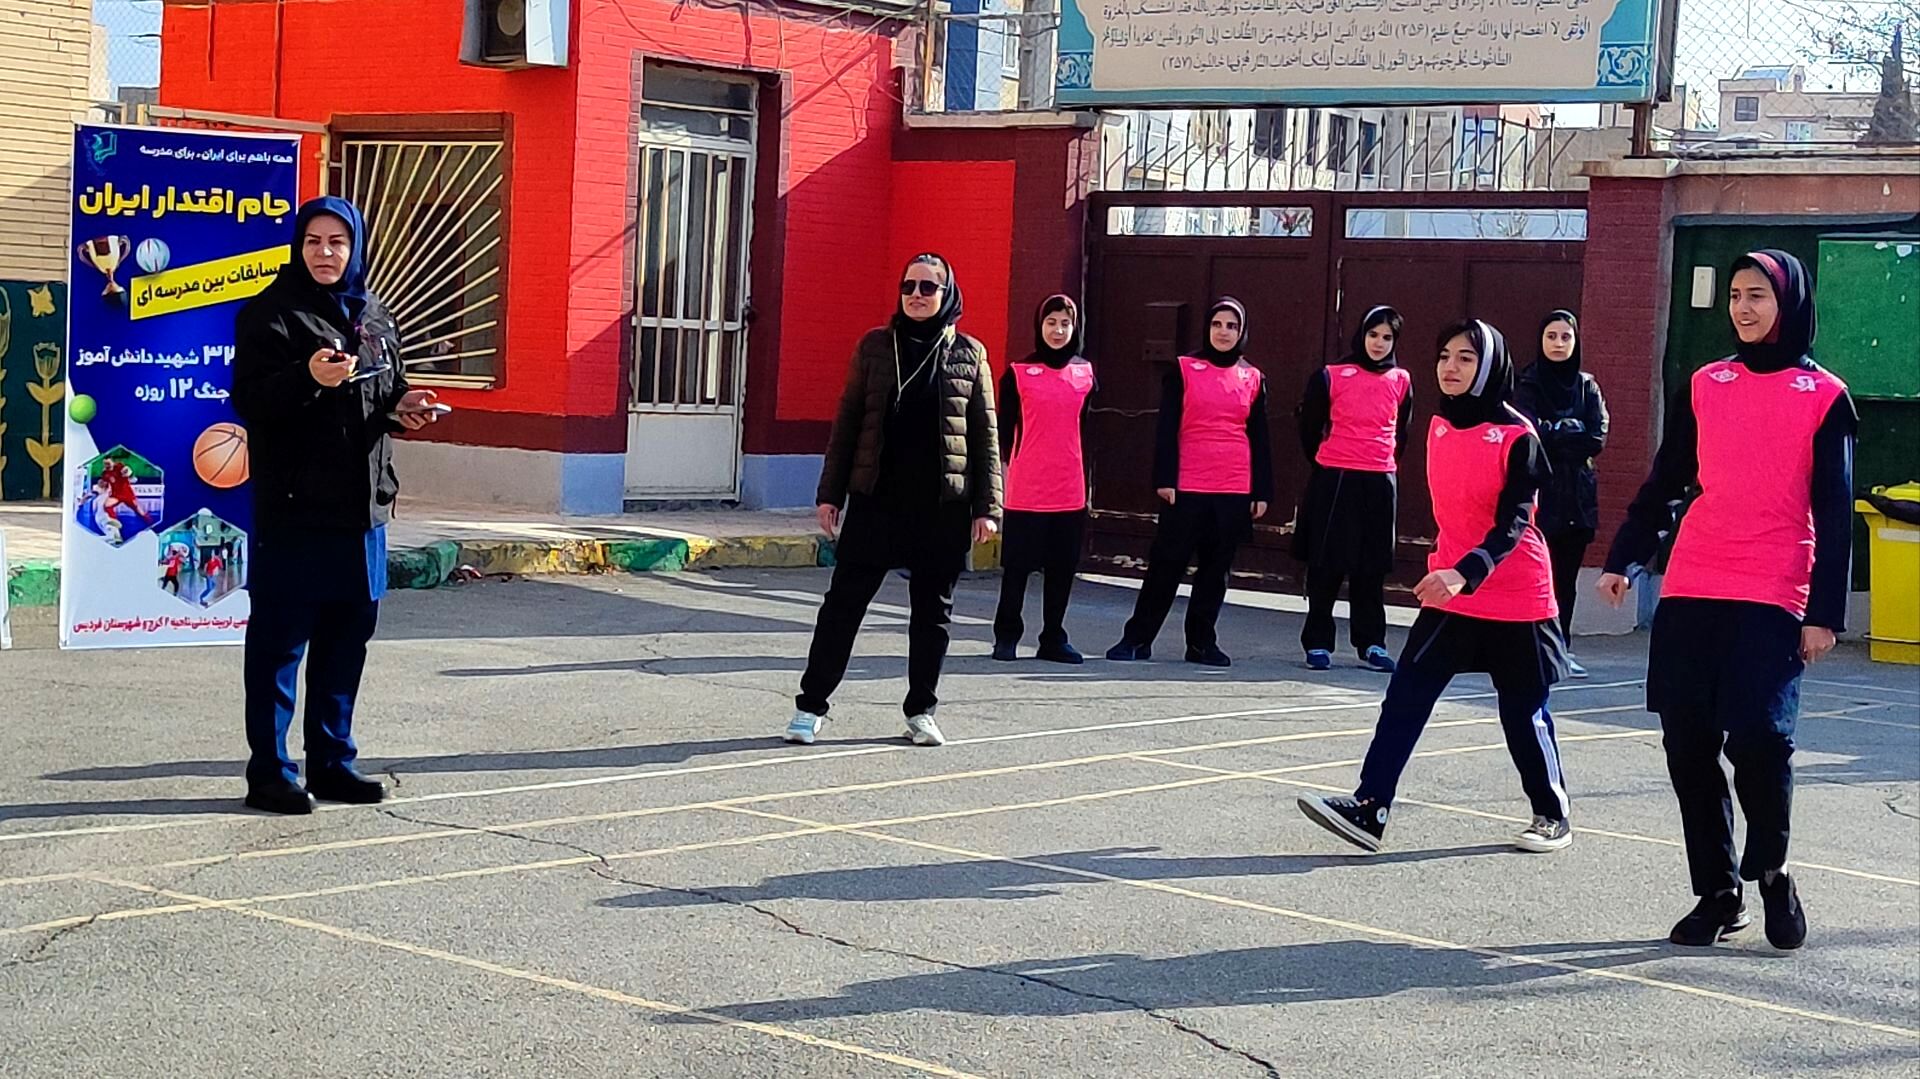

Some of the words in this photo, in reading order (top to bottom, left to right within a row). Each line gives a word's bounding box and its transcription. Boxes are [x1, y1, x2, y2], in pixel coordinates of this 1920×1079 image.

[139, 145, 173, 157] مدرسه
[174, 146, 195, 160] برای
[225, 150, 247, 163] برای
[272, 154, 294, 164] همه
[79, 182, 150, 216] ایران
[152, 186, 234, 218] اقتدار
[237, 191, 290, 224] جام
[227, 262, 280, 284] سابقات
[137, 284, 154, 307] ای
[155, 280, 200, 300] مدرسه
[203, 277, 226, 294] بین
[75, 345, 112, 366] آموز
[111, 348, 154, 367] دانش
[155, 348, 200, 369] شهید
[134, 383, 165, 402] روزه
[169, 377, 193, 399] ۱۲
[193, 382, 230, 405] جنگ
